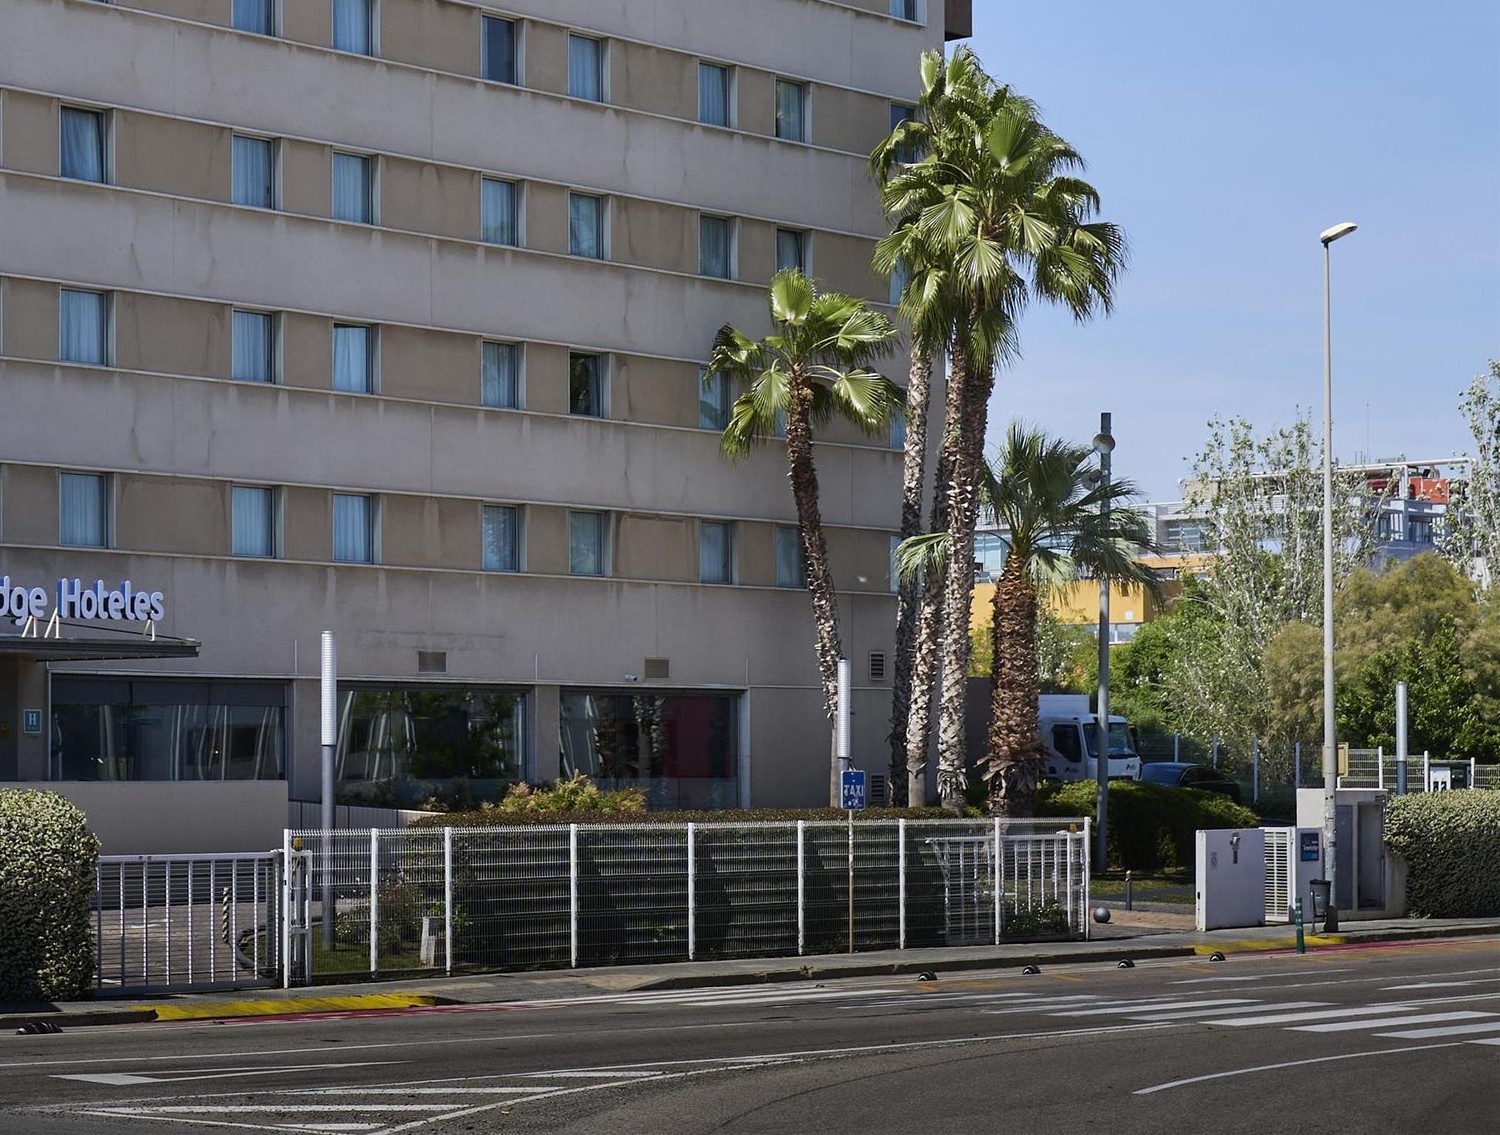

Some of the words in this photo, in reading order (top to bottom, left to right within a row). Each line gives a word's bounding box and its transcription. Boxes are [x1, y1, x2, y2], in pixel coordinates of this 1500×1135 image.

[58, 578, 165, 621] Hoteles
[29, 712, 37, 725] H
[843, 784, 864, 797] TAXI
